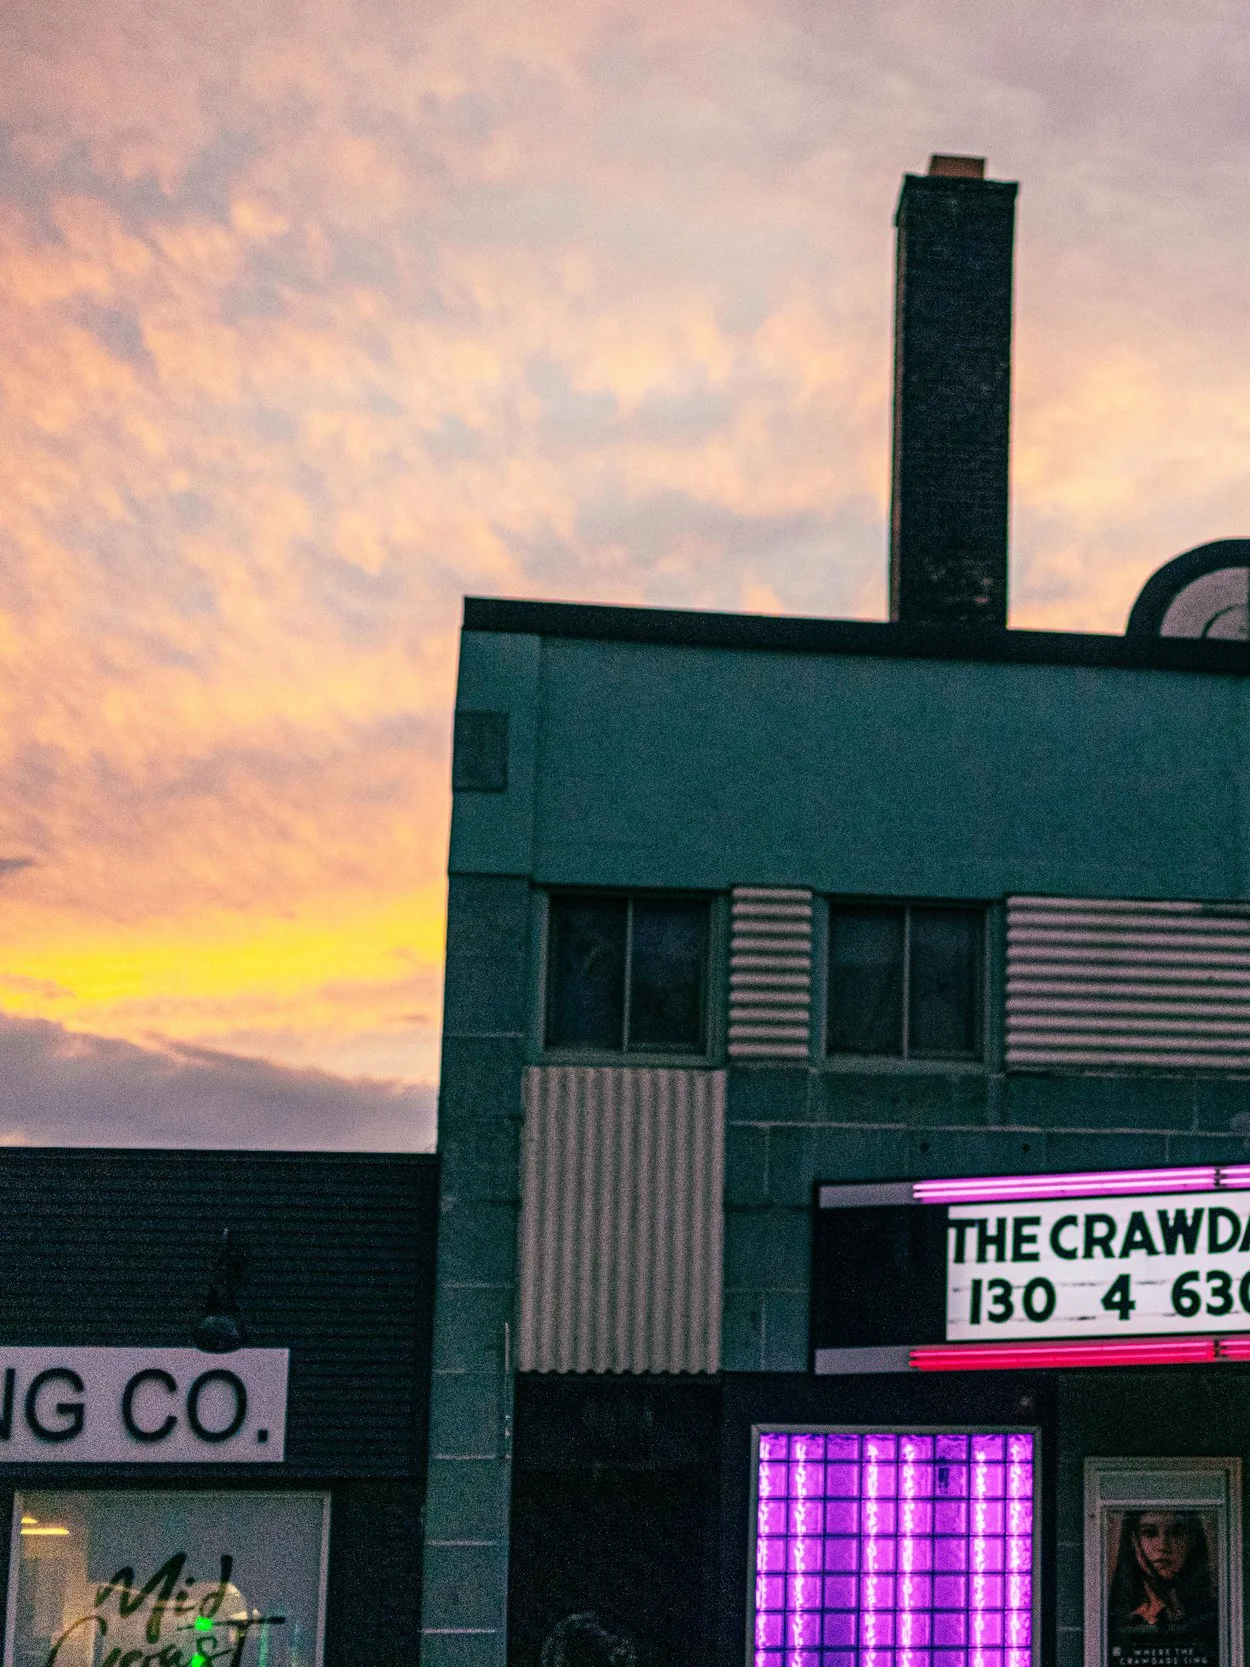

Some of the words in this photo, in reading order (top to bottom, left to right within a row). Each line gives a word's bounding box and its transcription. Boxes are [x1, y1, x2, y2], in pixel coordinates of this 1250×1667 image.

[949, 1215, 1041, 1264] THE
[969, 1277, 1056, 1326] 130
[1101, 1273, 1136, 1321] 4
[121, 1367, 269, 1444] CO.
